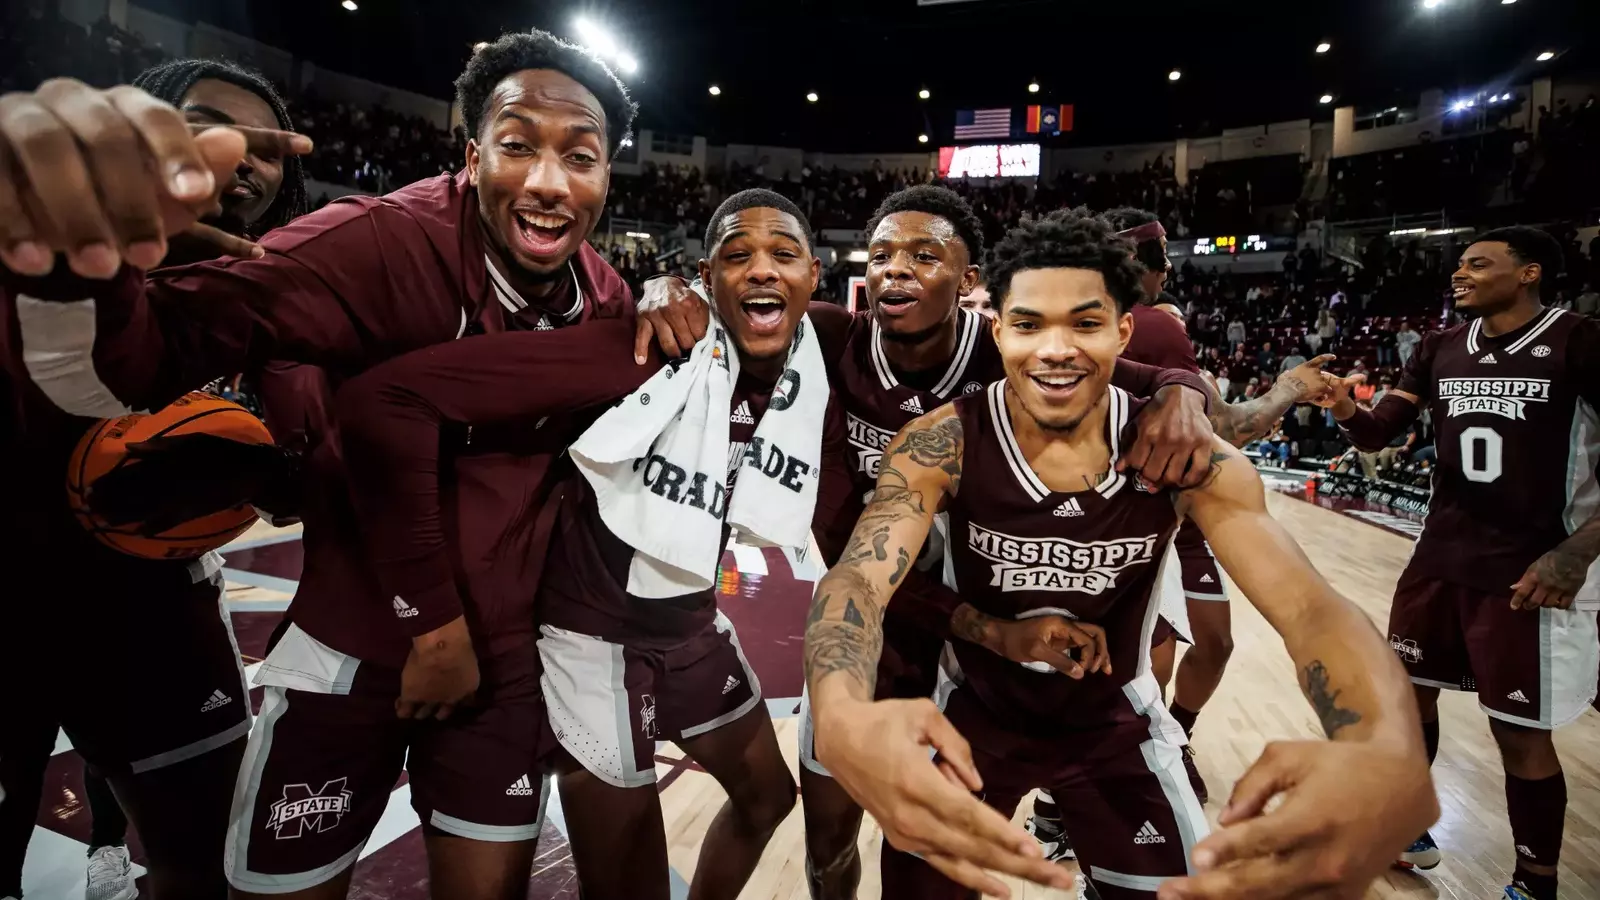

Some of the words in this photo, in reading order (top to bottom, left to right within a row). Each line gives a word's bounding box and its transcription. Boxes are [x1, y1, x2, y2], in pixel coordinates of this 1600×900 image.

[1533, 346, 1551, 357] SEC
[1439, 380, 1551, 399] MISSISSIPPI
[899, 403, 925, 415] adidas
[1457, 398, 1510, 415] STATE
[729, 412, 755, 426] adidas
[846, 416, 893, 450] MISS
[1053, 508, 1086, 518] adidas
[968, 525, 1157, 570] MISSISSIPPI
[1011, 570, 1098, 592] STATE
[200, 696, 232, 713] adidas
[505, 787, 533, 796] adidas
[284, 799, 339, 819] STATE
[1133, 835, 1166, 845] adidas
